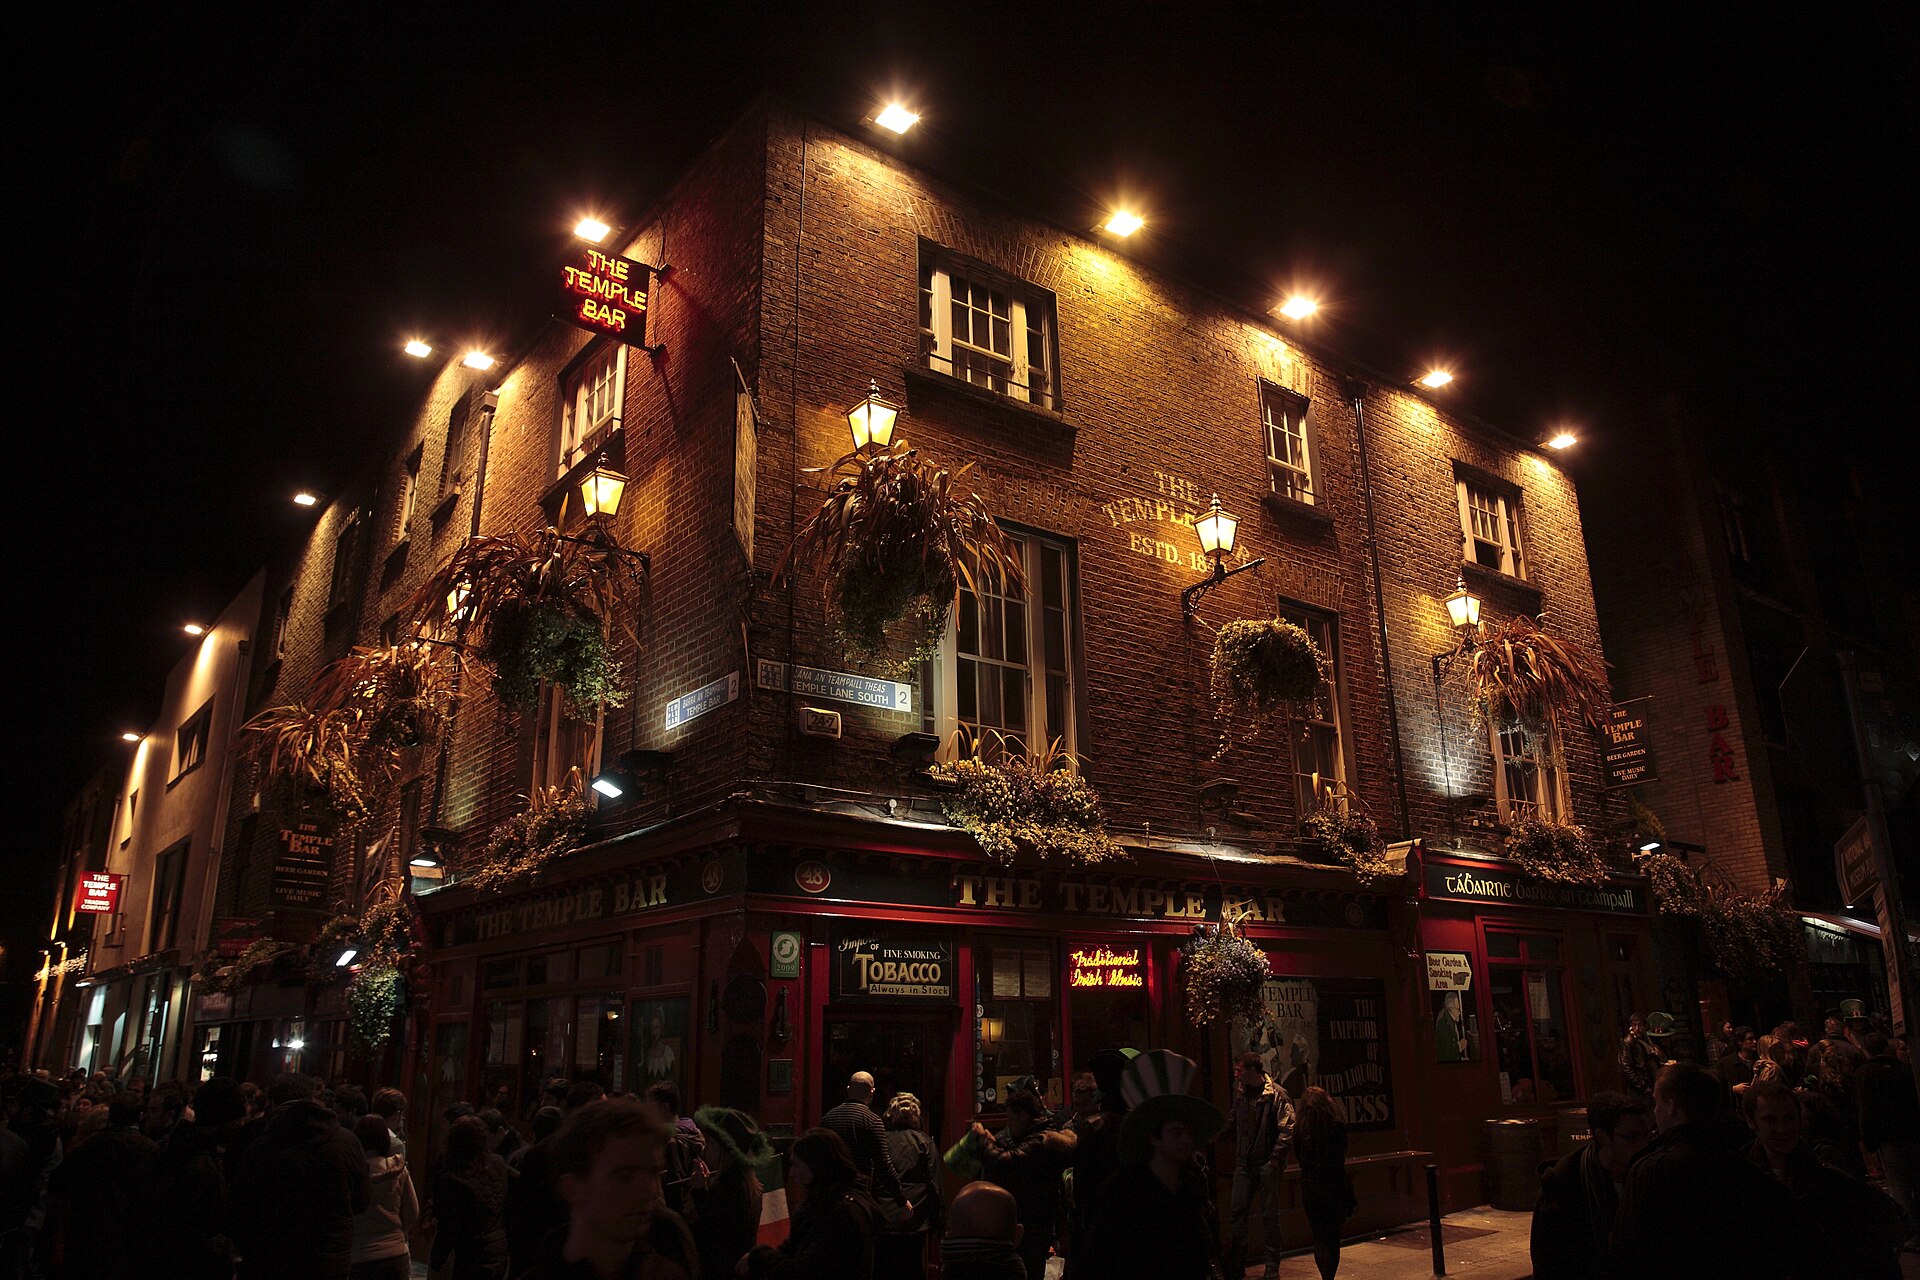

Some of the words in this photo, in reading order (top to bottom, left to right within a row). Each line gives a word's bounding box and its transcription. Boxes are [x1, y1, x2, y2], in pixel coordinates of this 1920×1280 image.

[588, 249, 629, 280] THE
[564, 266, 647, 310] TEMPLE
[582, 299, 626, 329] BAR
[1154, 471, 1200, 505] THE
[1130, 531, 1183, 566] ESTD.
[731, 679, 737, 694] 2
[792, 681, 827, 695] TEMPLE
[830, 686, 855, 700] LANE
[858, 691, 889, 705] SOUTH
[827, 675, 863, 690] TEAMPAILL
[864, 682, 886, 695] THEAS
[687, 700, 708, 717] TEMPLE
[708, 694, 721, 707] BAR
[899, 691, 908, 704] 2
[1612, 709, 1628, 719] THE
[1602, 719, 1643, 736] TEMPLE
[1612, 731, 1636, 744] BAR
[1704, 703, 1740, 784] BAR
[1622, 748, 1646, 758] GARDEN
[1627, 765, 1646, 774] MUSIC
[280, 829, 333, 846] TEMPLE
[288, 839, 321, 854] BAR
[93, 874, 110, 882] THE
[804, 866, 823, 885] 48
[83, 880, 117, 891] TEMPLE
[88, 888, 108, 897] BAR
[475, 911, 513, 940] THE
[519, 890, 603, 932] TEMPLE
[614, 875, 668, 913] BAR
[953, 873, 1043, 909] THE
[1059, 880, 1207, 920] TEMPLE
[1223, 898, 1287, 924] BAR
[883, 949, 903, 959] FINE
[904, 950, 940, 960] SMOKING
[1072, 949, 1139, 968] Traditional
[852, 953, 942, 990] TOBACCO
[1072, 968, 1103, 987] Irish
[1107, 968, 1143, 987] Music
[870, 984, 905, 995] Always
[909, 985, 918, 994] in
[921, 984, 949, 995] Stock
[1260, 985, 1315, 1002] TEMPLE
[1277, 1002, 1304, 1019] BAR
[1354, 999, 1376, 1017] THE
[1330, 1020, 1378, 1040] EMPEROR
